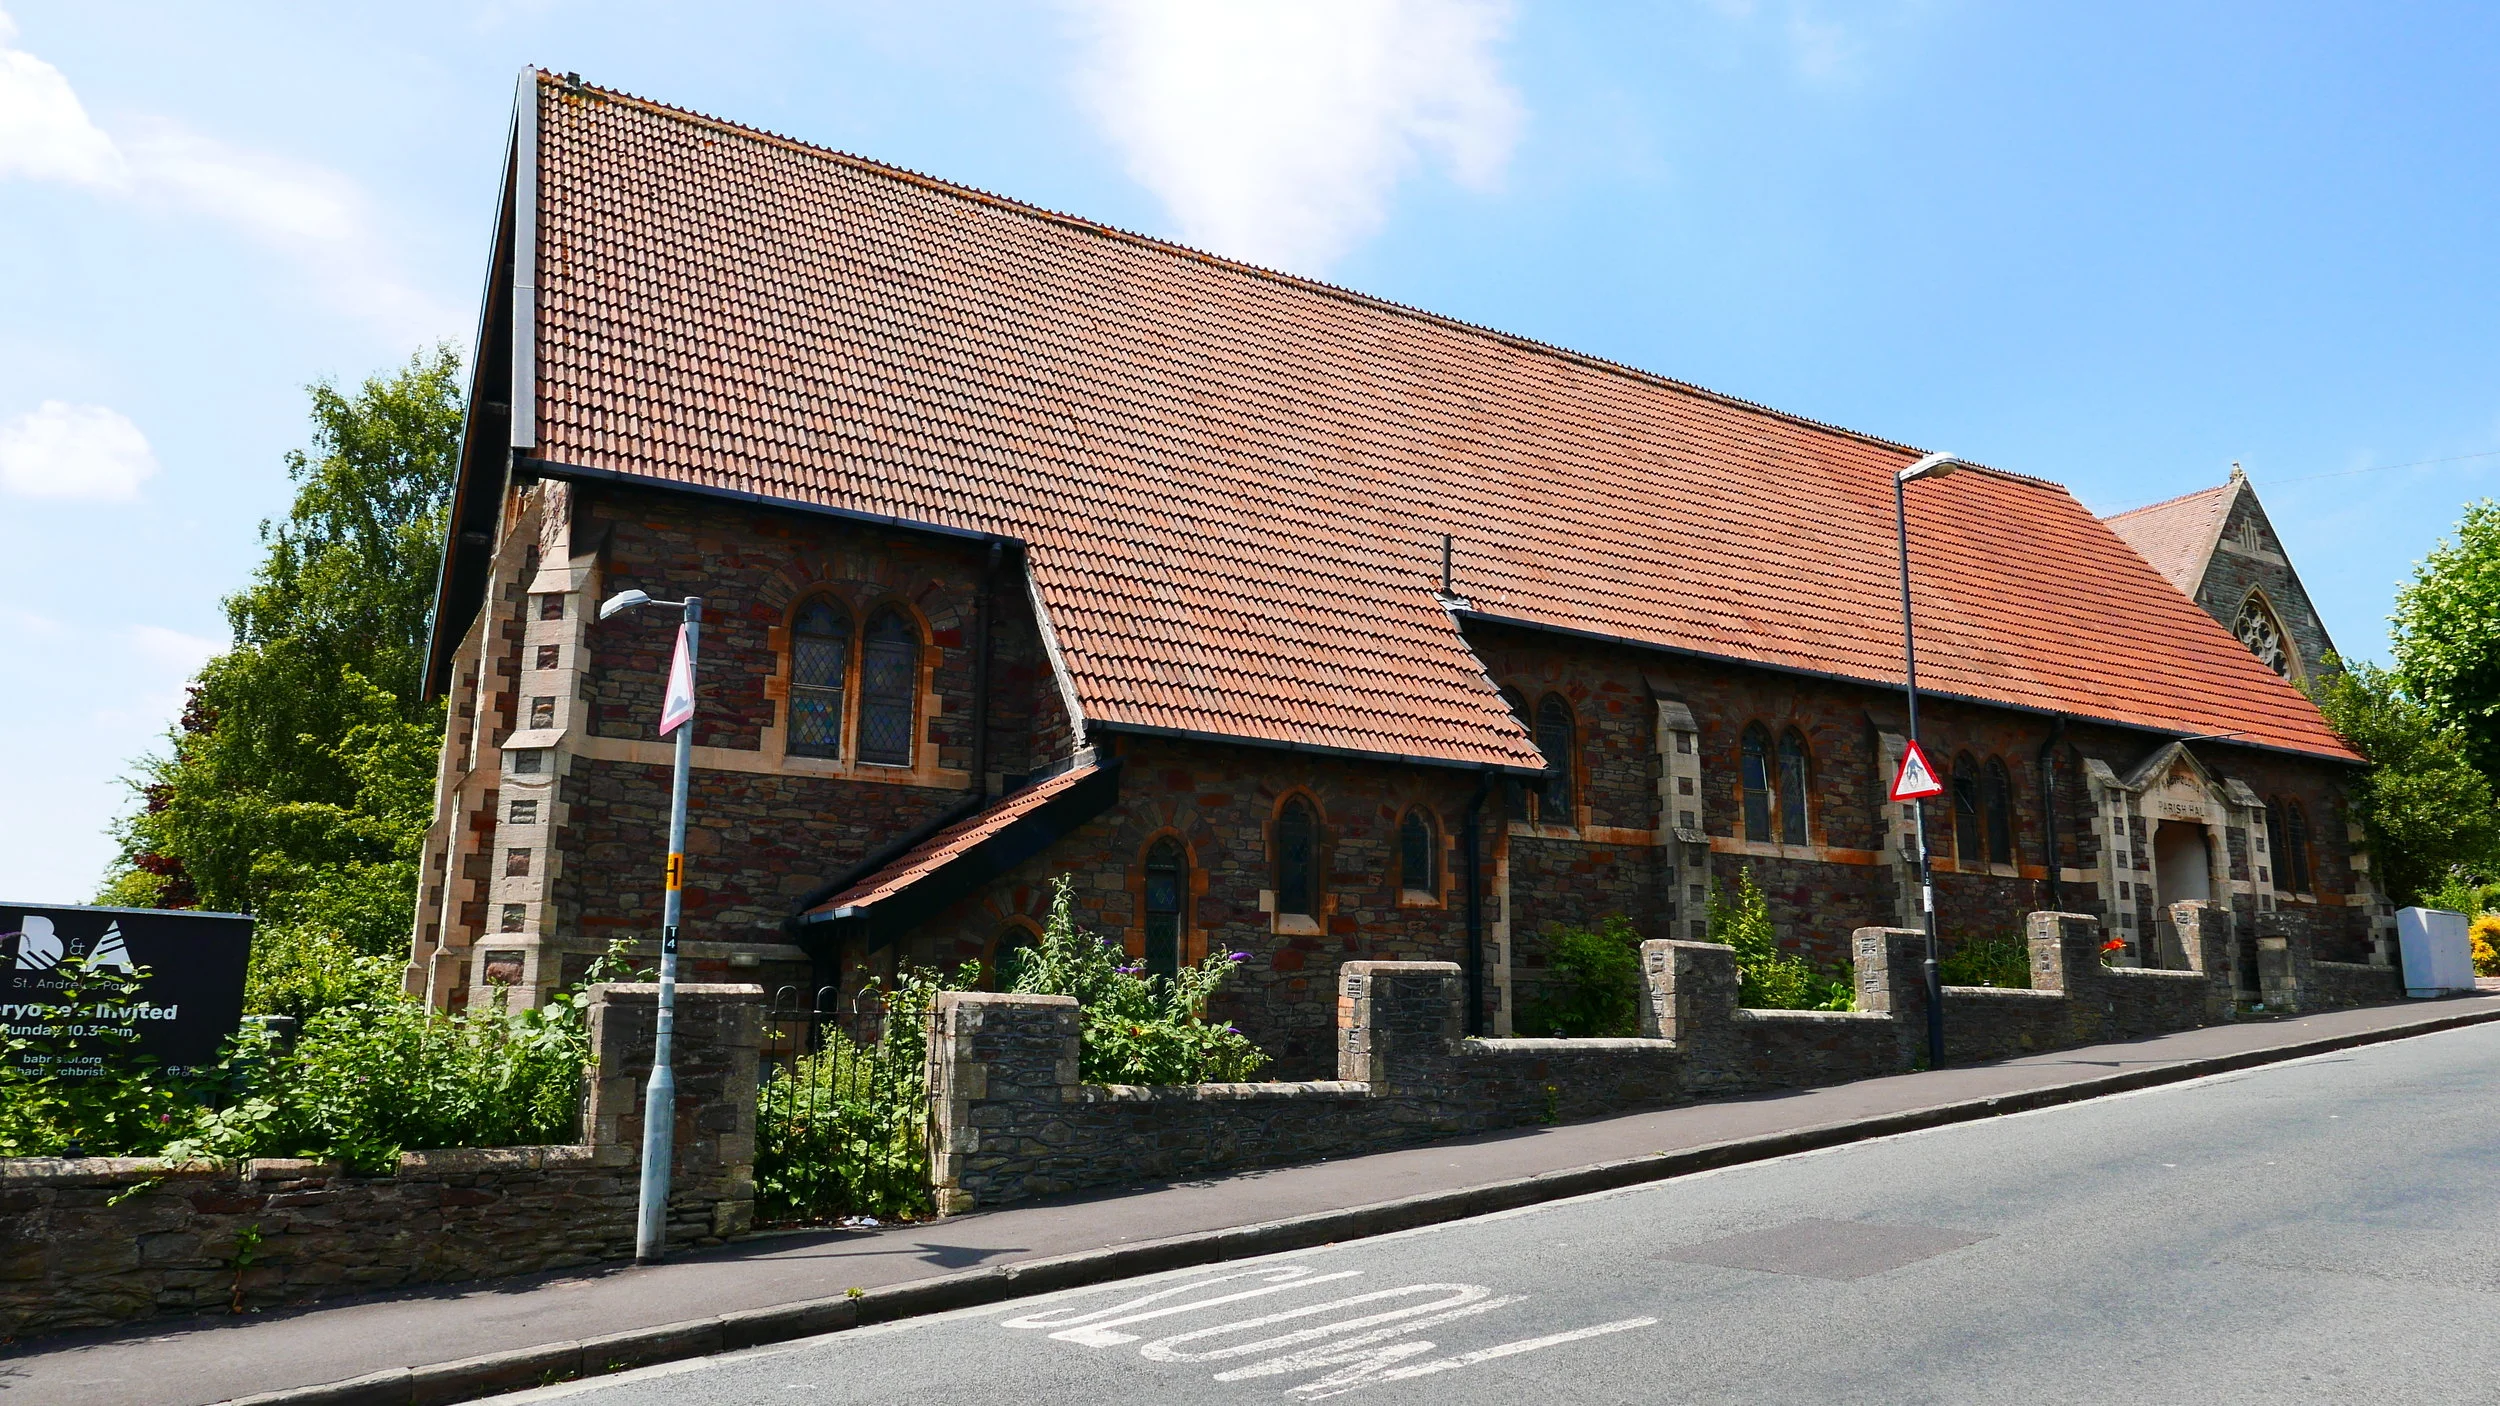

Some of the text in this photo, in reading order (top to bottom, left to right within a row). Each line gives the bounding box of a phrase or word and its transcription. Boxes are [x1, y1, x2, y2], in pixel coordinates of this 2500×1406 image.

[2158, 801, 2206, 817] PARISH HAL
[15, 915, 132, 974] B & A
[13, 977, 32, 989] St.
[96, 1003, 178, 1020] Invited
[1000, 1264, 1660, 1402] SLOW
